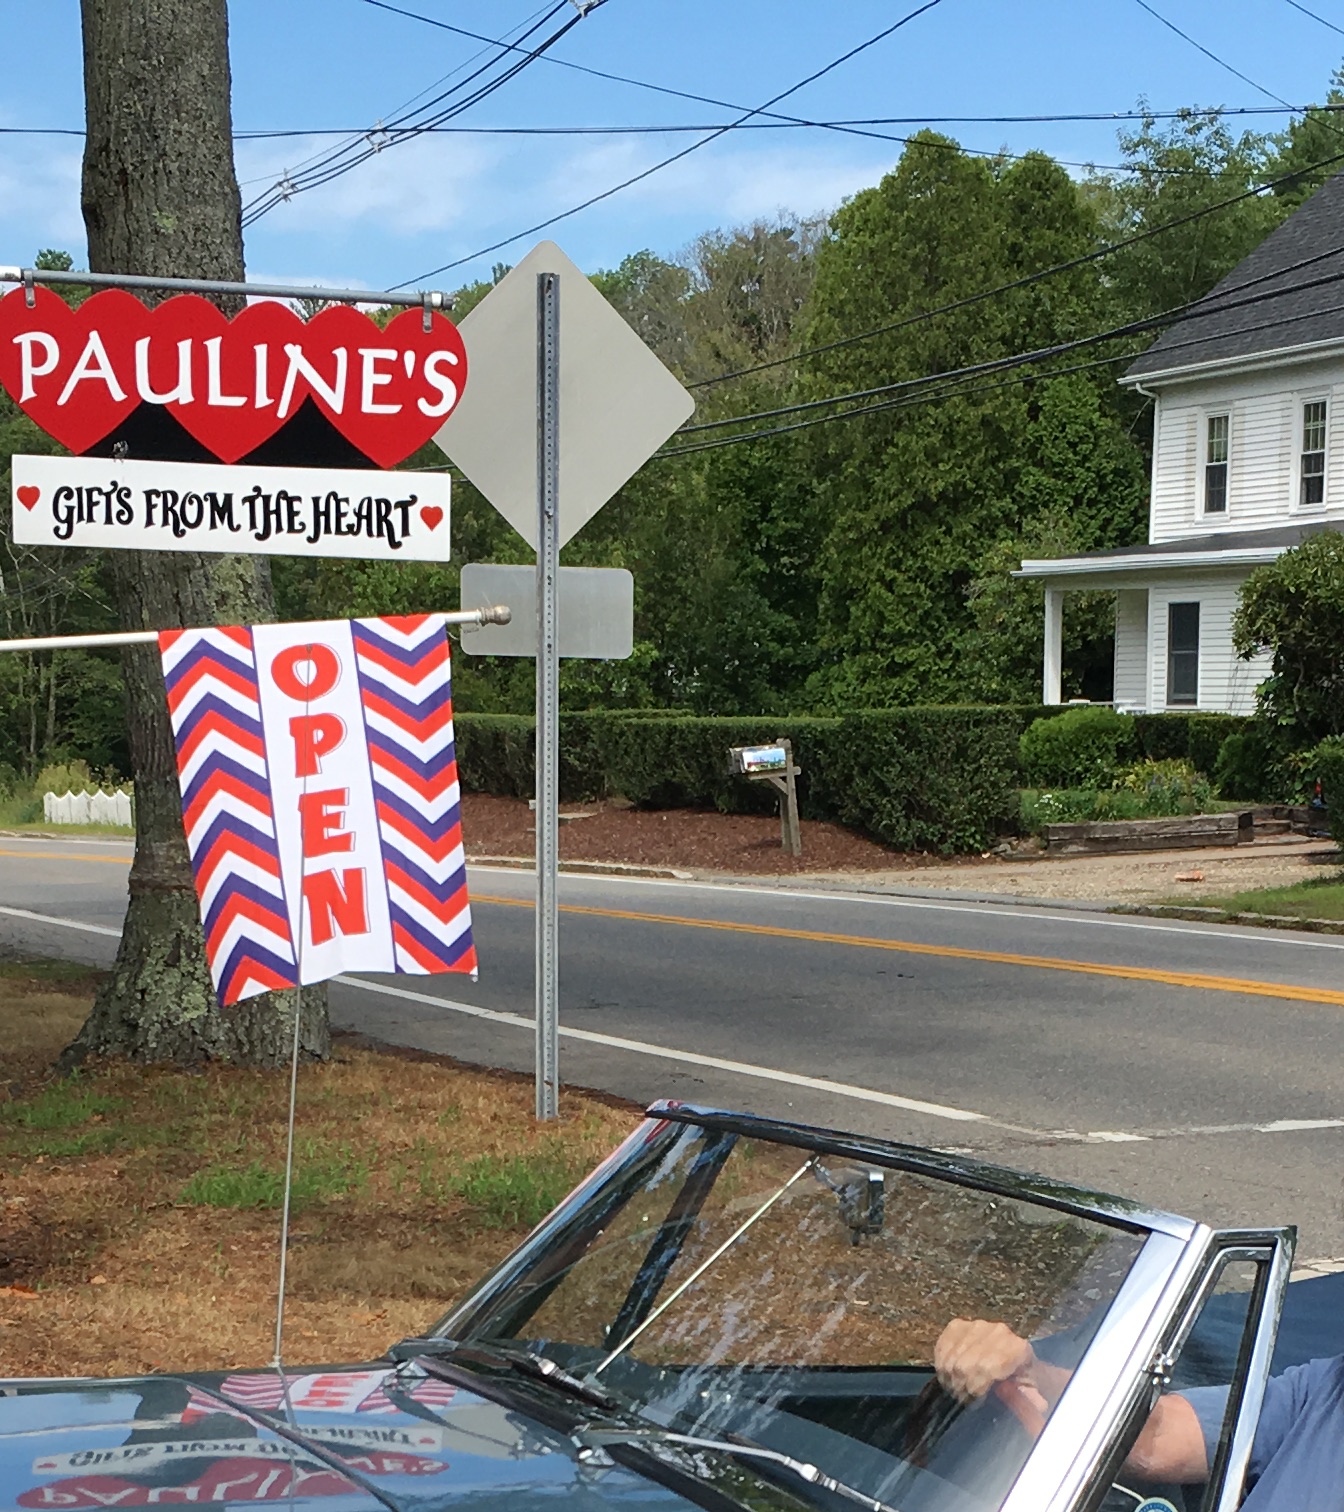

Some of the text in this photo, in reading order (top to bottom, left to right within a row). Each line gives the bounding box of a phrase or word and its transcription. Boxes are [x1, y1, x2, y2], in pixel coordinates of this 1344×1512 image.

[12, 330, 458, 419] PAULINE'S
[52, 480, 418, 550] GIFTS FROM THE HEART
[270, 643, 371, 946] OPEN
